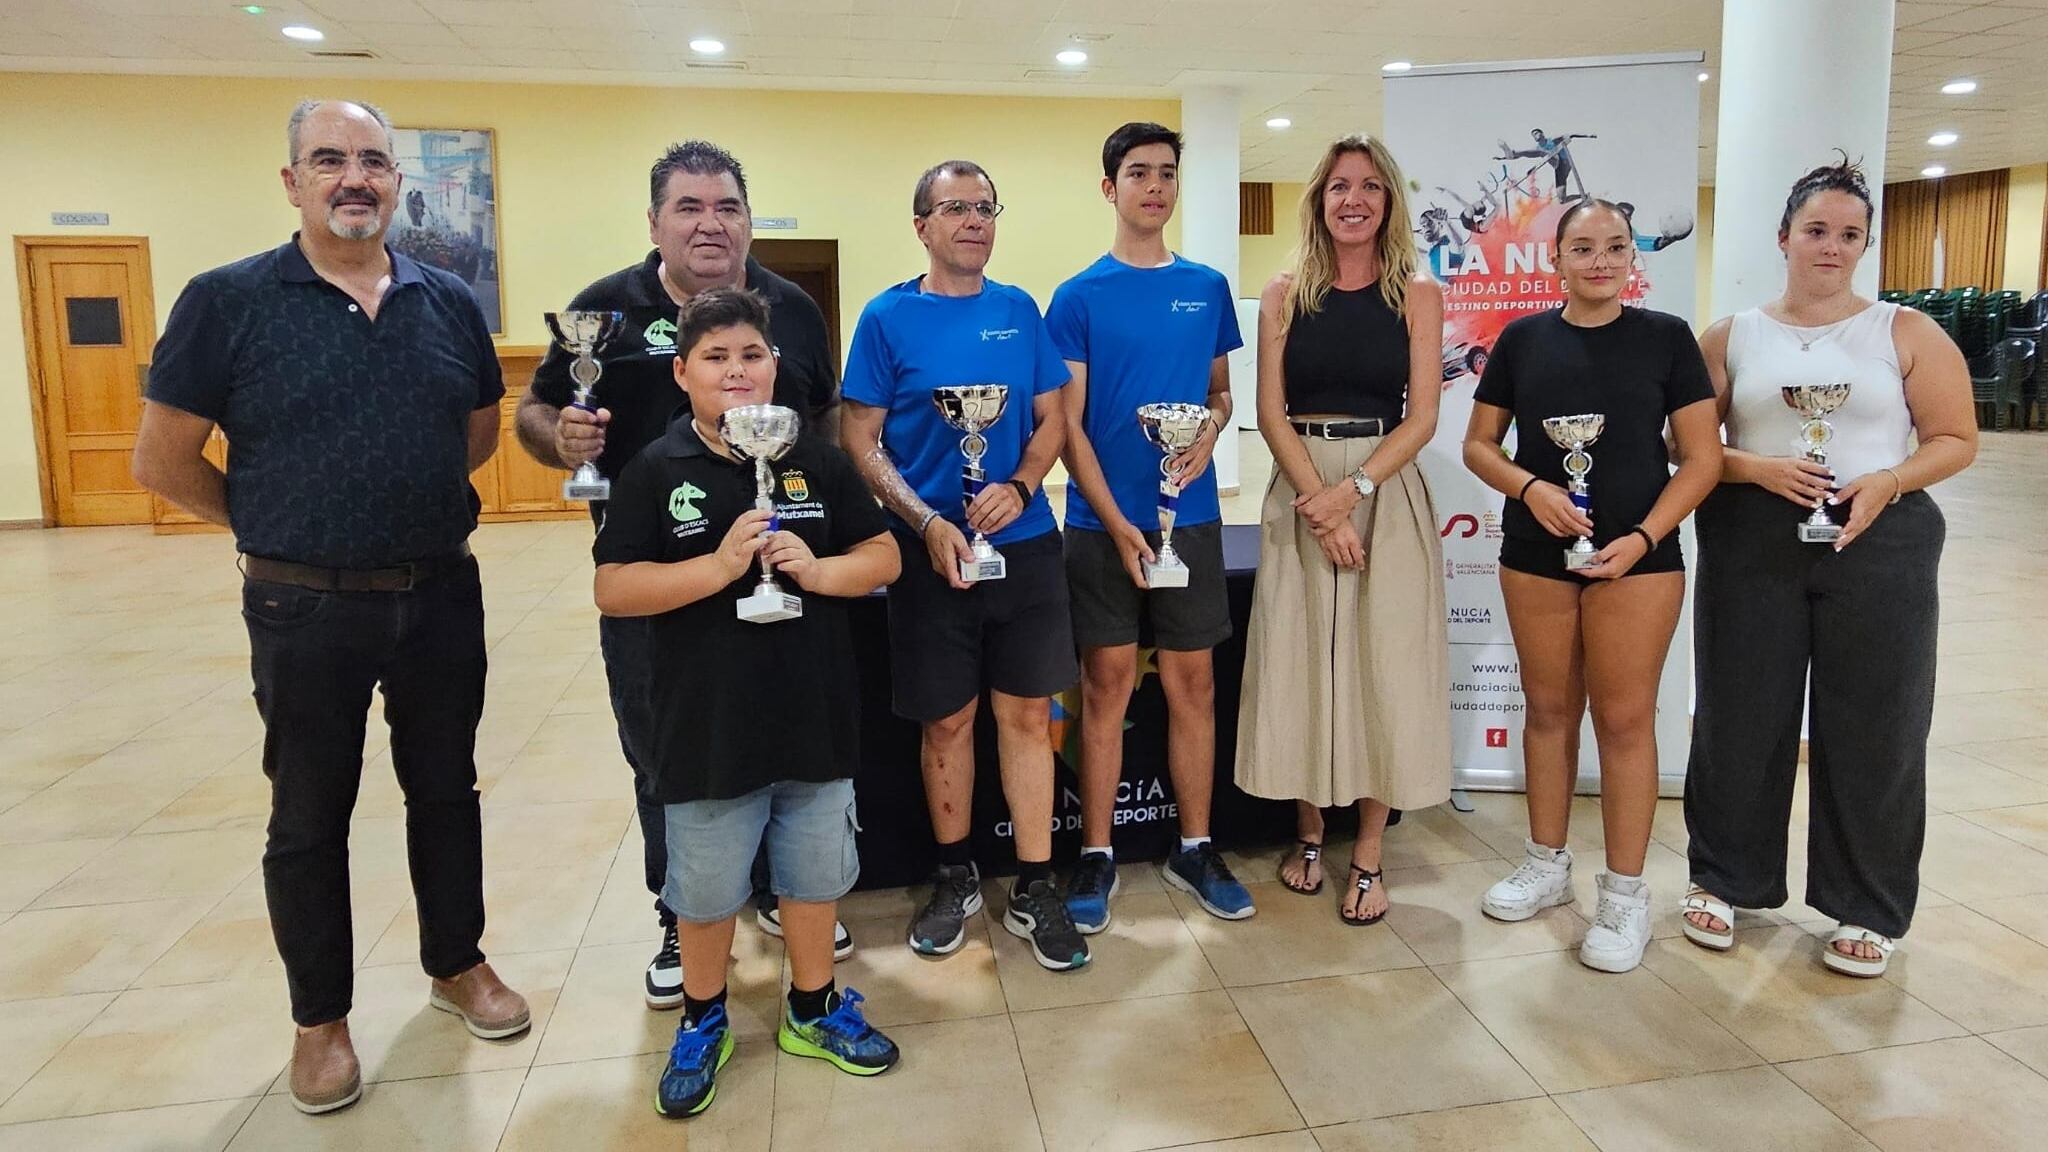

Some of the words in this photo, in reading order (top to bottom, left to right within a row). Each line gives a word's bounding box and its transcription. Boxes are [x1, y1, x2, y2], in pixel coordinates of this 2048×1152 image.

[1440, 244, 1490, 276] LA
[1520, 280, 1553, 295] DEL
[1444, 302, 1491, 312] ESTINO
[1495, 300, 1563, 311] DEPORTIVO
[1472, 662, 1518, 673] www.l
[1450, 701, 1524, 713] iudaddepor
[1113, 803, 1178, 825] EPORTE
